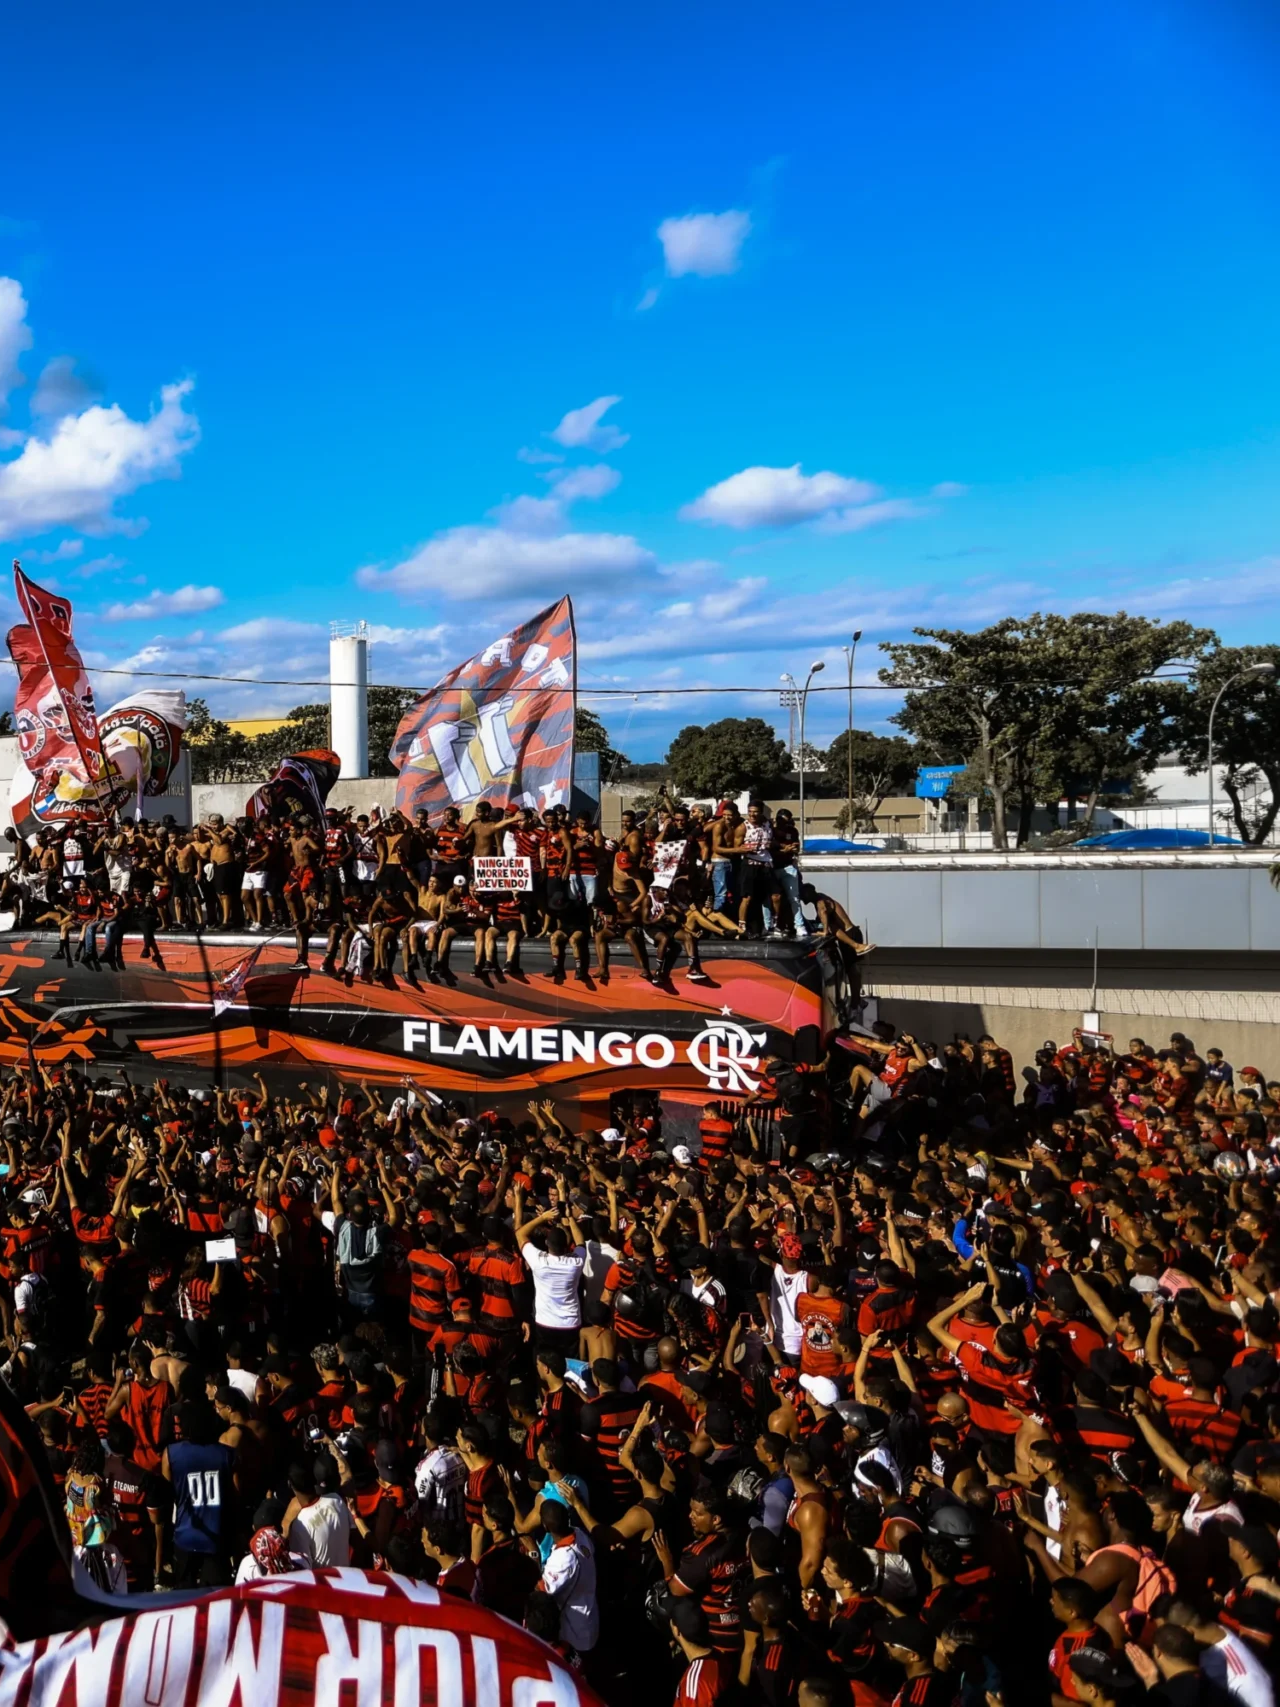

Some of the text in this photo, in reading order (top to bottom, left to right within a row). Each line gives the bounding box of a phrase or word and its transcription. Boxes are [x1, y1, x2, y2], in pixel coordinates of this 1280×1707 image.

[478, 857, 524, 868] NINGUÉM
[477, 868, 530, 879] MORRE NOS
[479, 879, 528, 890] DEVENDO!
[402, 1021, 676, 1069] FLAMENGO
[113, 1480, 139, 1493] ETERNAS
[187, 1470, 221, 1507] 00
